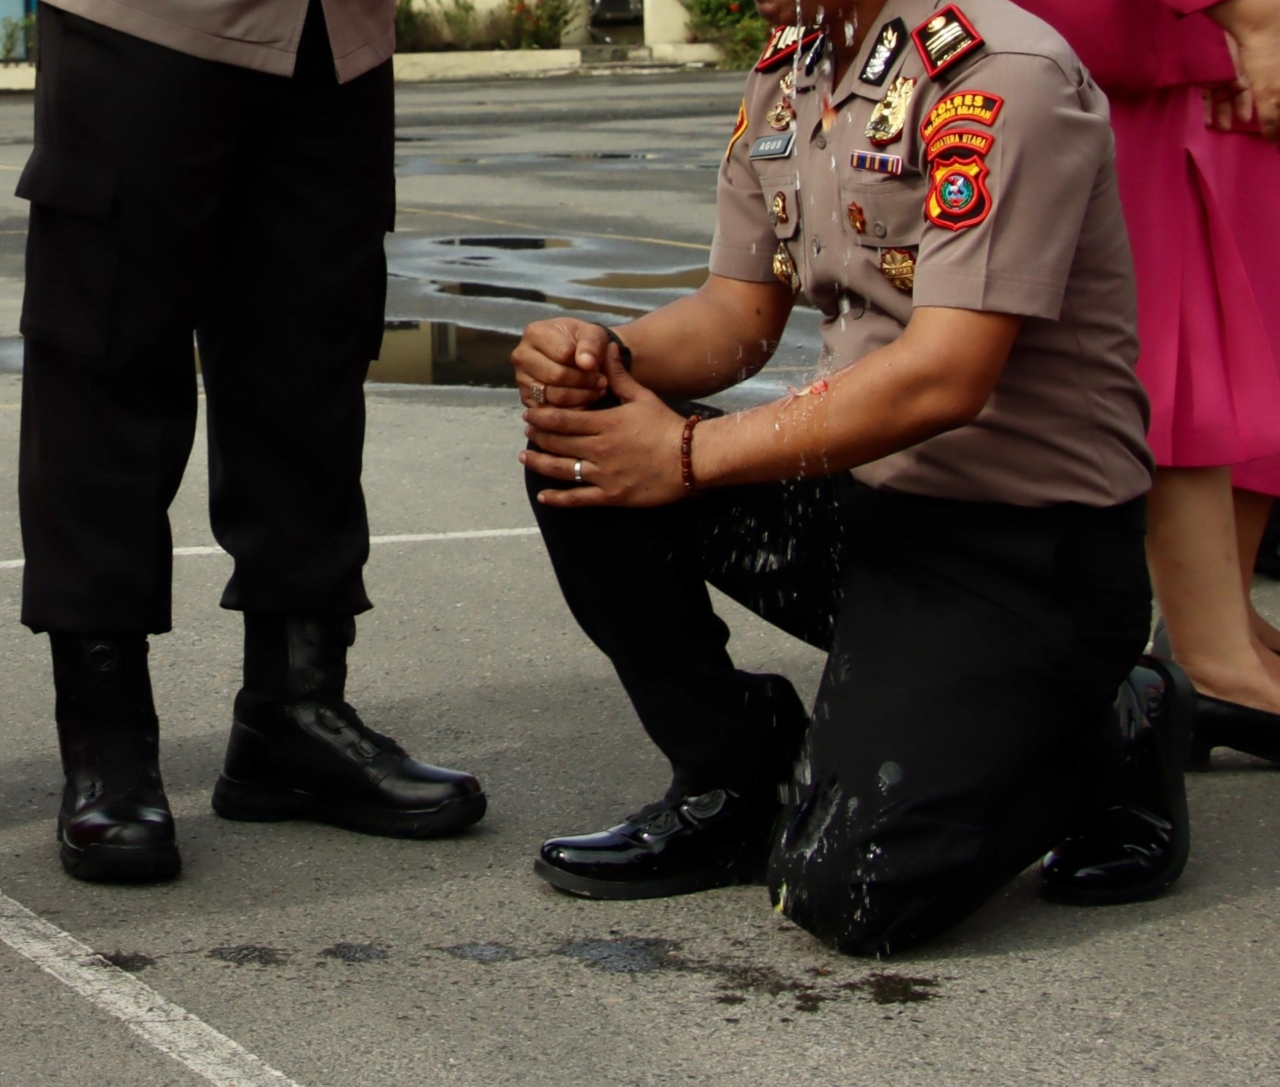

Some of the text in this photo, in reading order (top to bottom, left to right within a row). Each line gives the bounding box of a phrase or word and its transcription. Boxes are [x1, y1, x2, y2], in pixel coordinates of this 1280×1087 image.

[930, 94, 984, 122] POLRES
[758, 139, 782, 152] AGUS
[961, 133, 986, 149] UTARA
